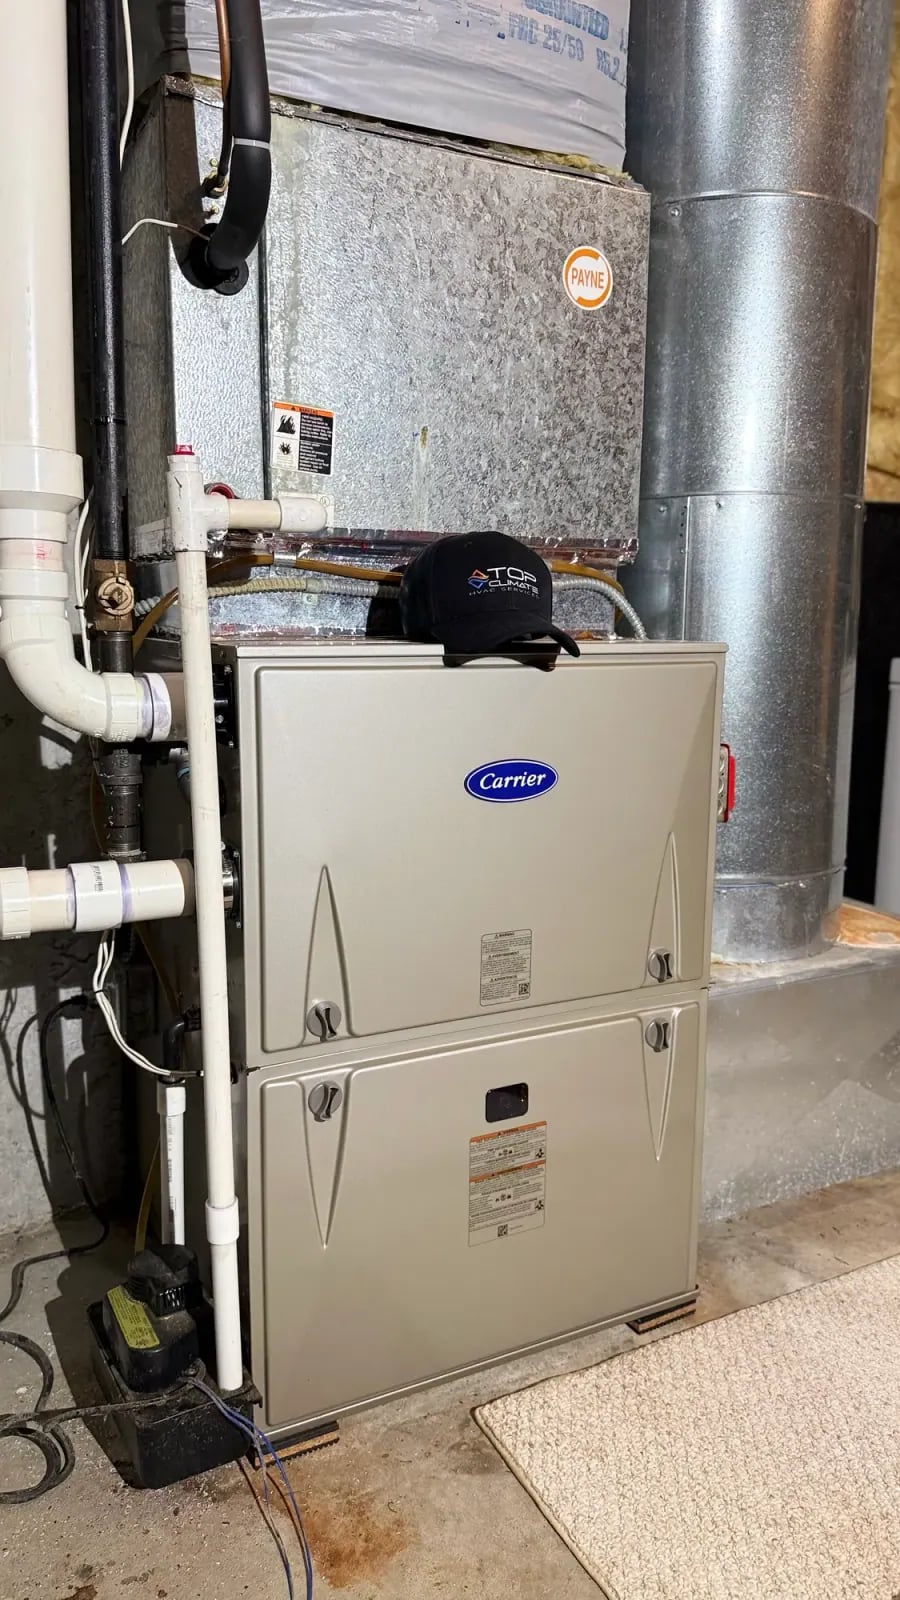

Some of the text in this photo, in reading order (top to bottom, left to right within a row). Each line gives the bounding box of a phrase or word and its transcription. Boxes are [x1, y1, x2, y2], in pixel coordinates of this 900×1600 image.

[571, 267, 604, 289] PAYNE
[487, 567, 537, 583] TOP
[469, 588, 496, 597] HVAC
[488, 579, 540, 594] CLIMATE
[479, 771, 547, 790] Carrier
